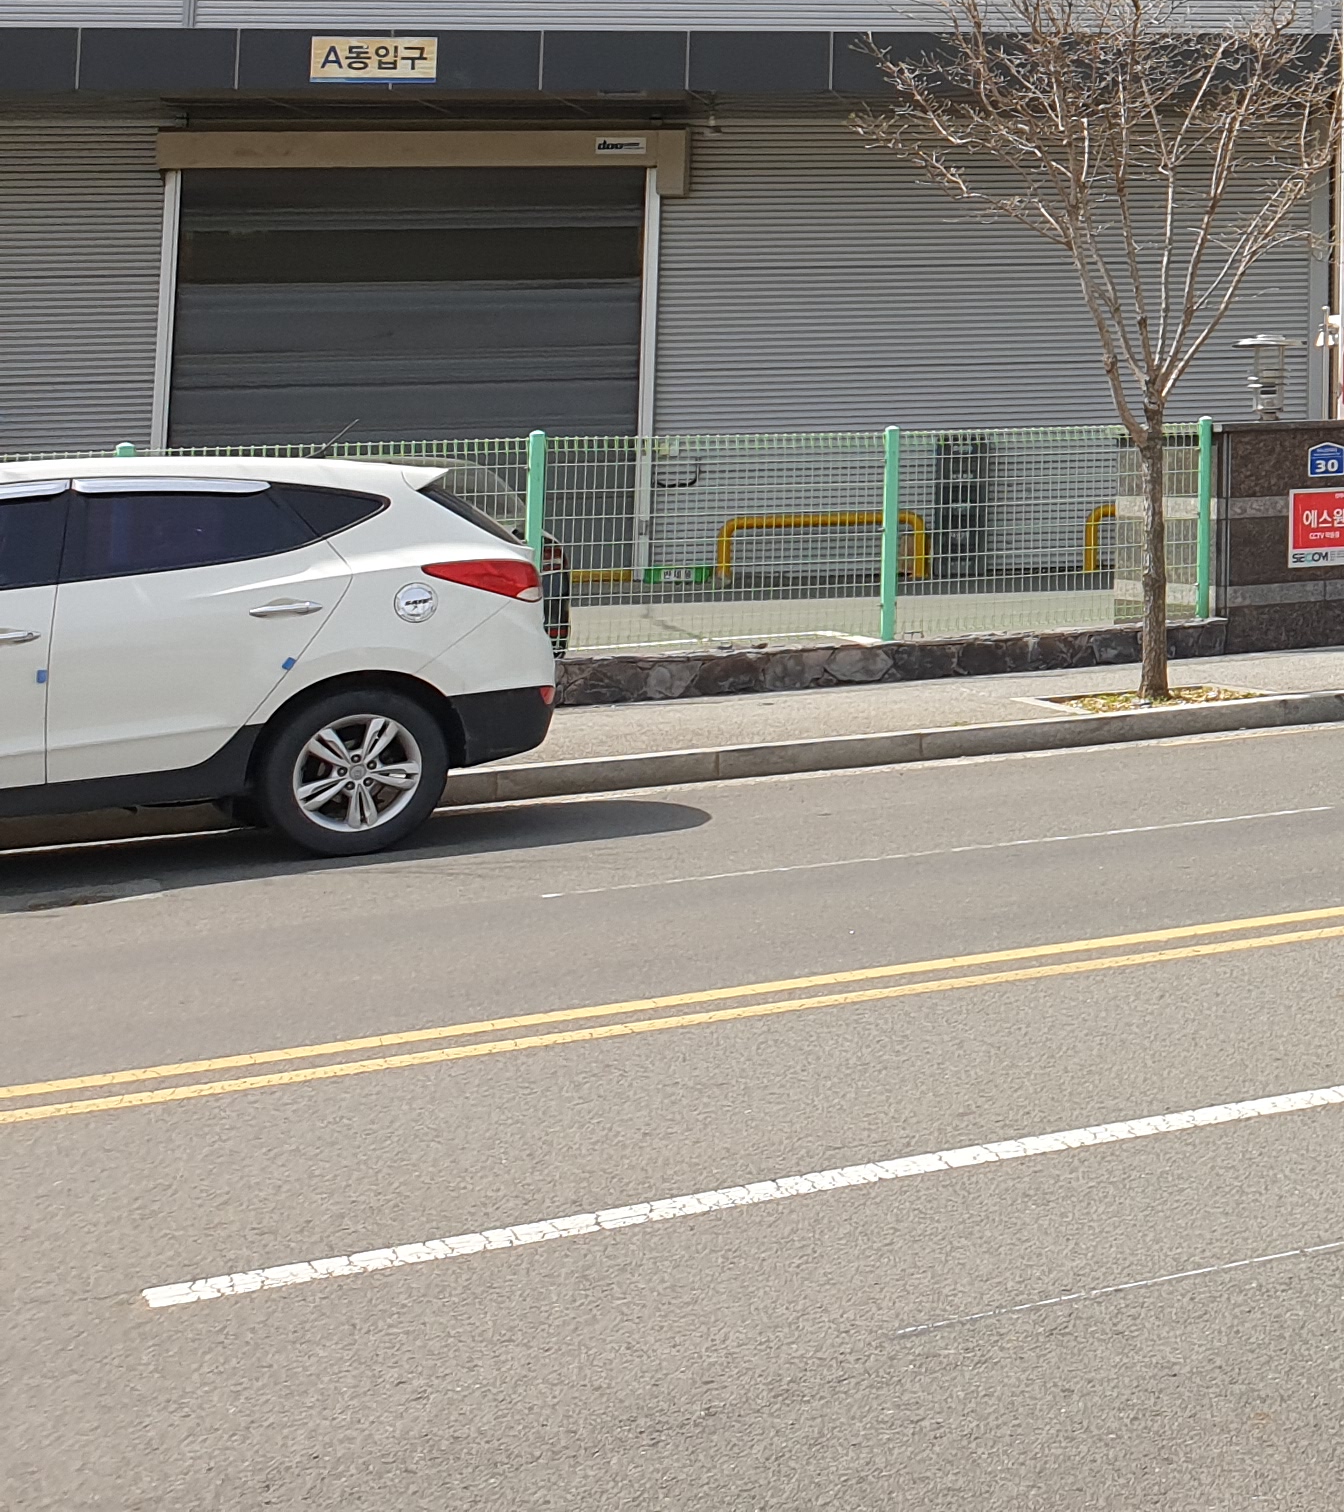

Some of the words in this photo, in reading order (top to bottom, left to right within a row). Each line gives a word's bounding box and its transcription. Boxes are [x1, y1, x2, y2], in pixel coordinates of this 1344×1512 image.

[320, 45, 428, 70] A동입구
[1315, 459, 1339, 473] 30
[1292, 551, 1329, 564] SECOM
